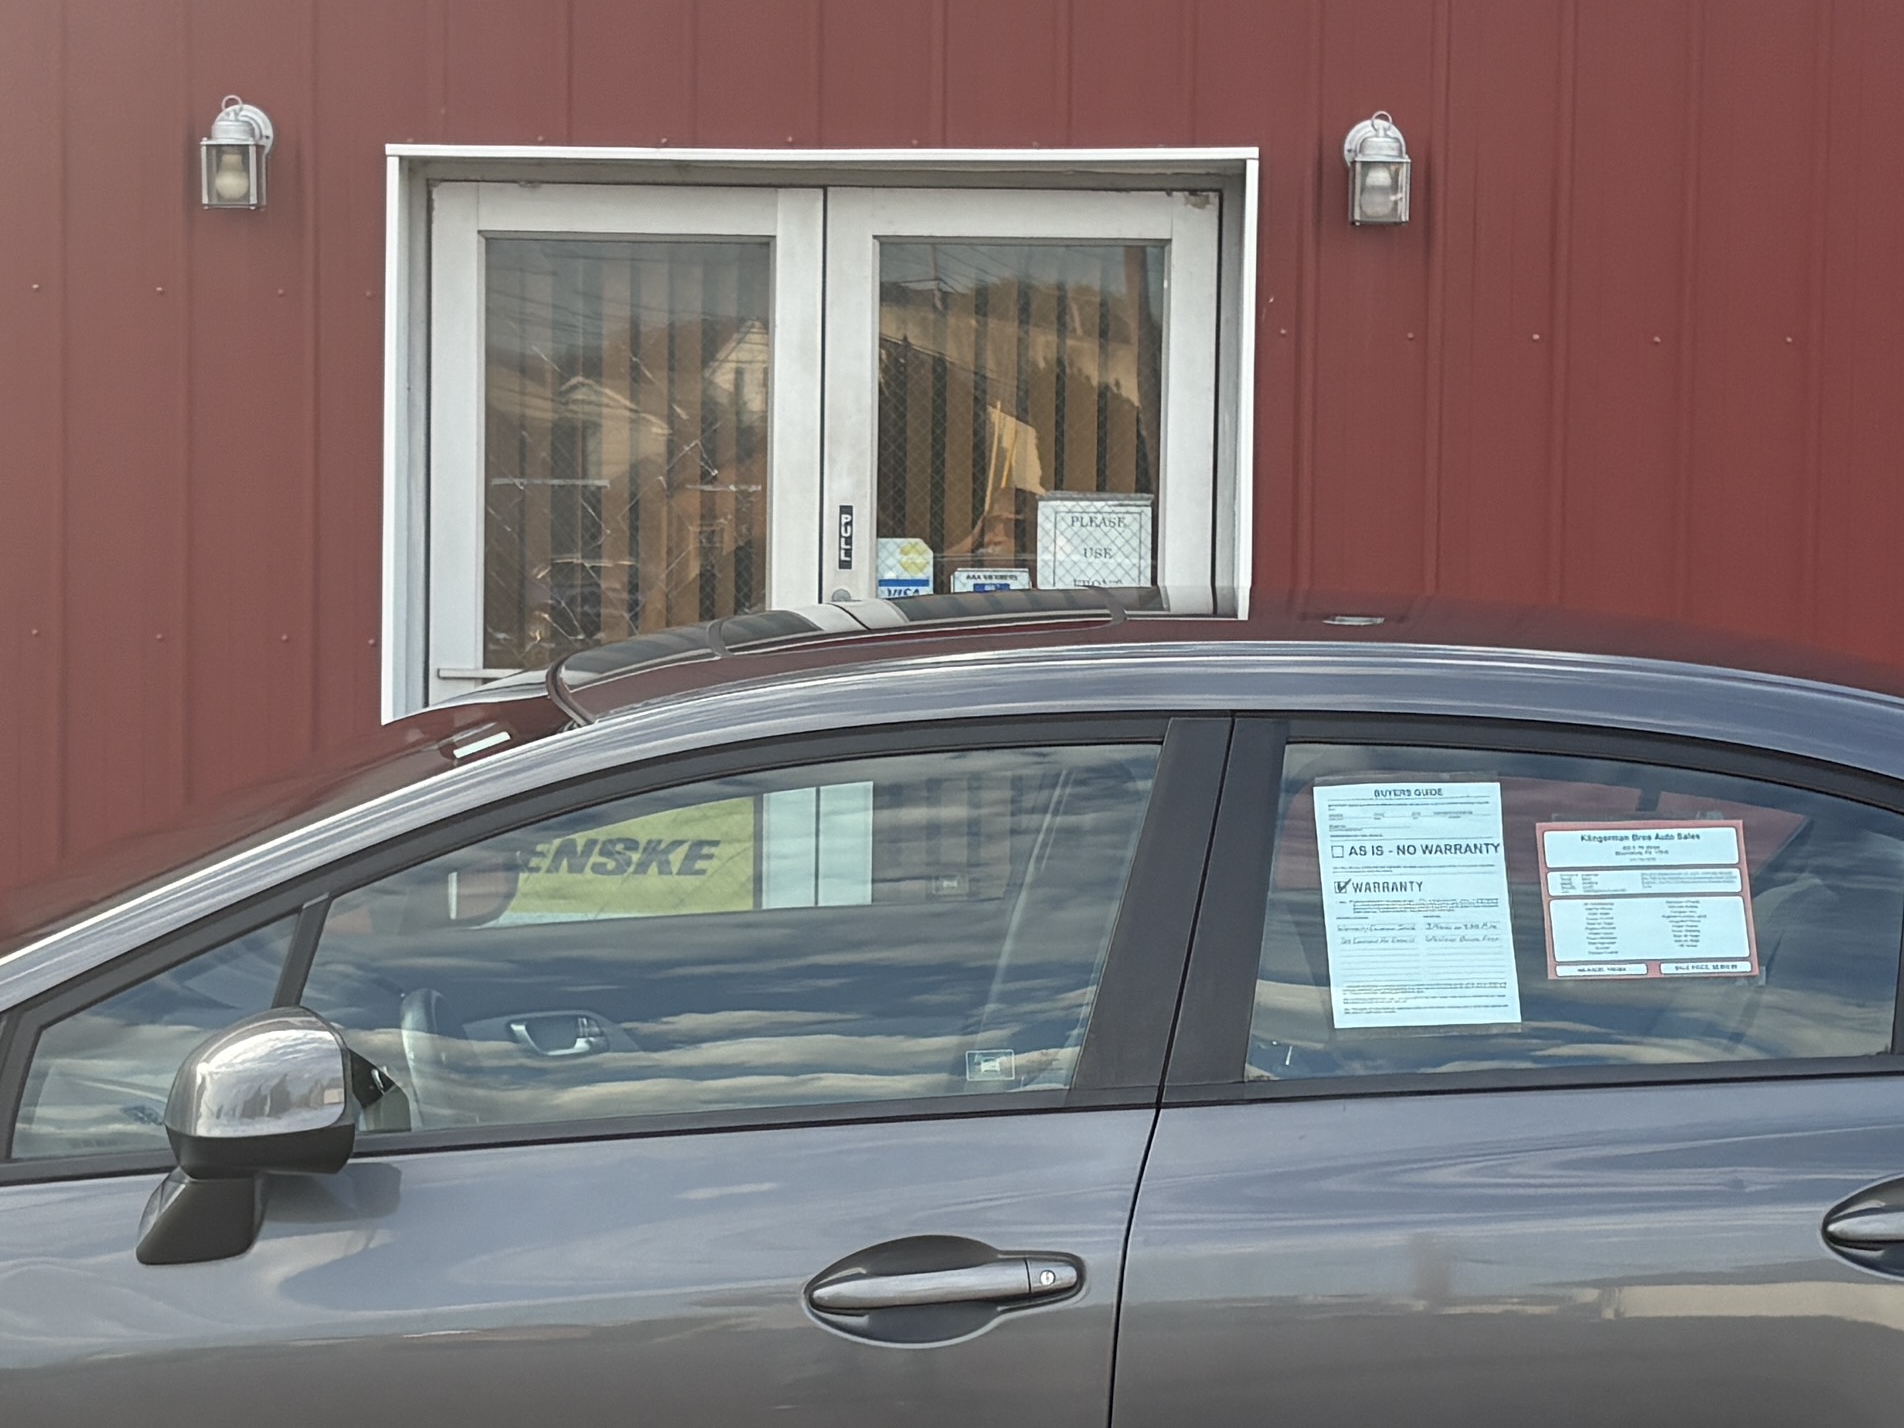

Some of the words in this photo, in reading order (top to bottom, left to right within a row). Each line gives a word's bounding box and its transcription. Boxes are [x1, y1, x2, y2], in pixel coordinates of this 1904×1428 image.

[1070, 515, 1127, 528] PLEASE
[840, 514, 852, 561] PULL
[1083, 547, 1114, 560] USE
[1655, 832, 1675, 841] Auto
[1677, 832, 1701, 841] Sales
[1348, 845, 1367, 857] AS
[1371, 845, 1384, 856] IS
[1396, 844, 1417, 856] NO
[1420, 842, 1501, 856] WARRANTY
[516, 838, 721, 876] ENSKE
[1351, 880, 1424, 893] WARRANTY
